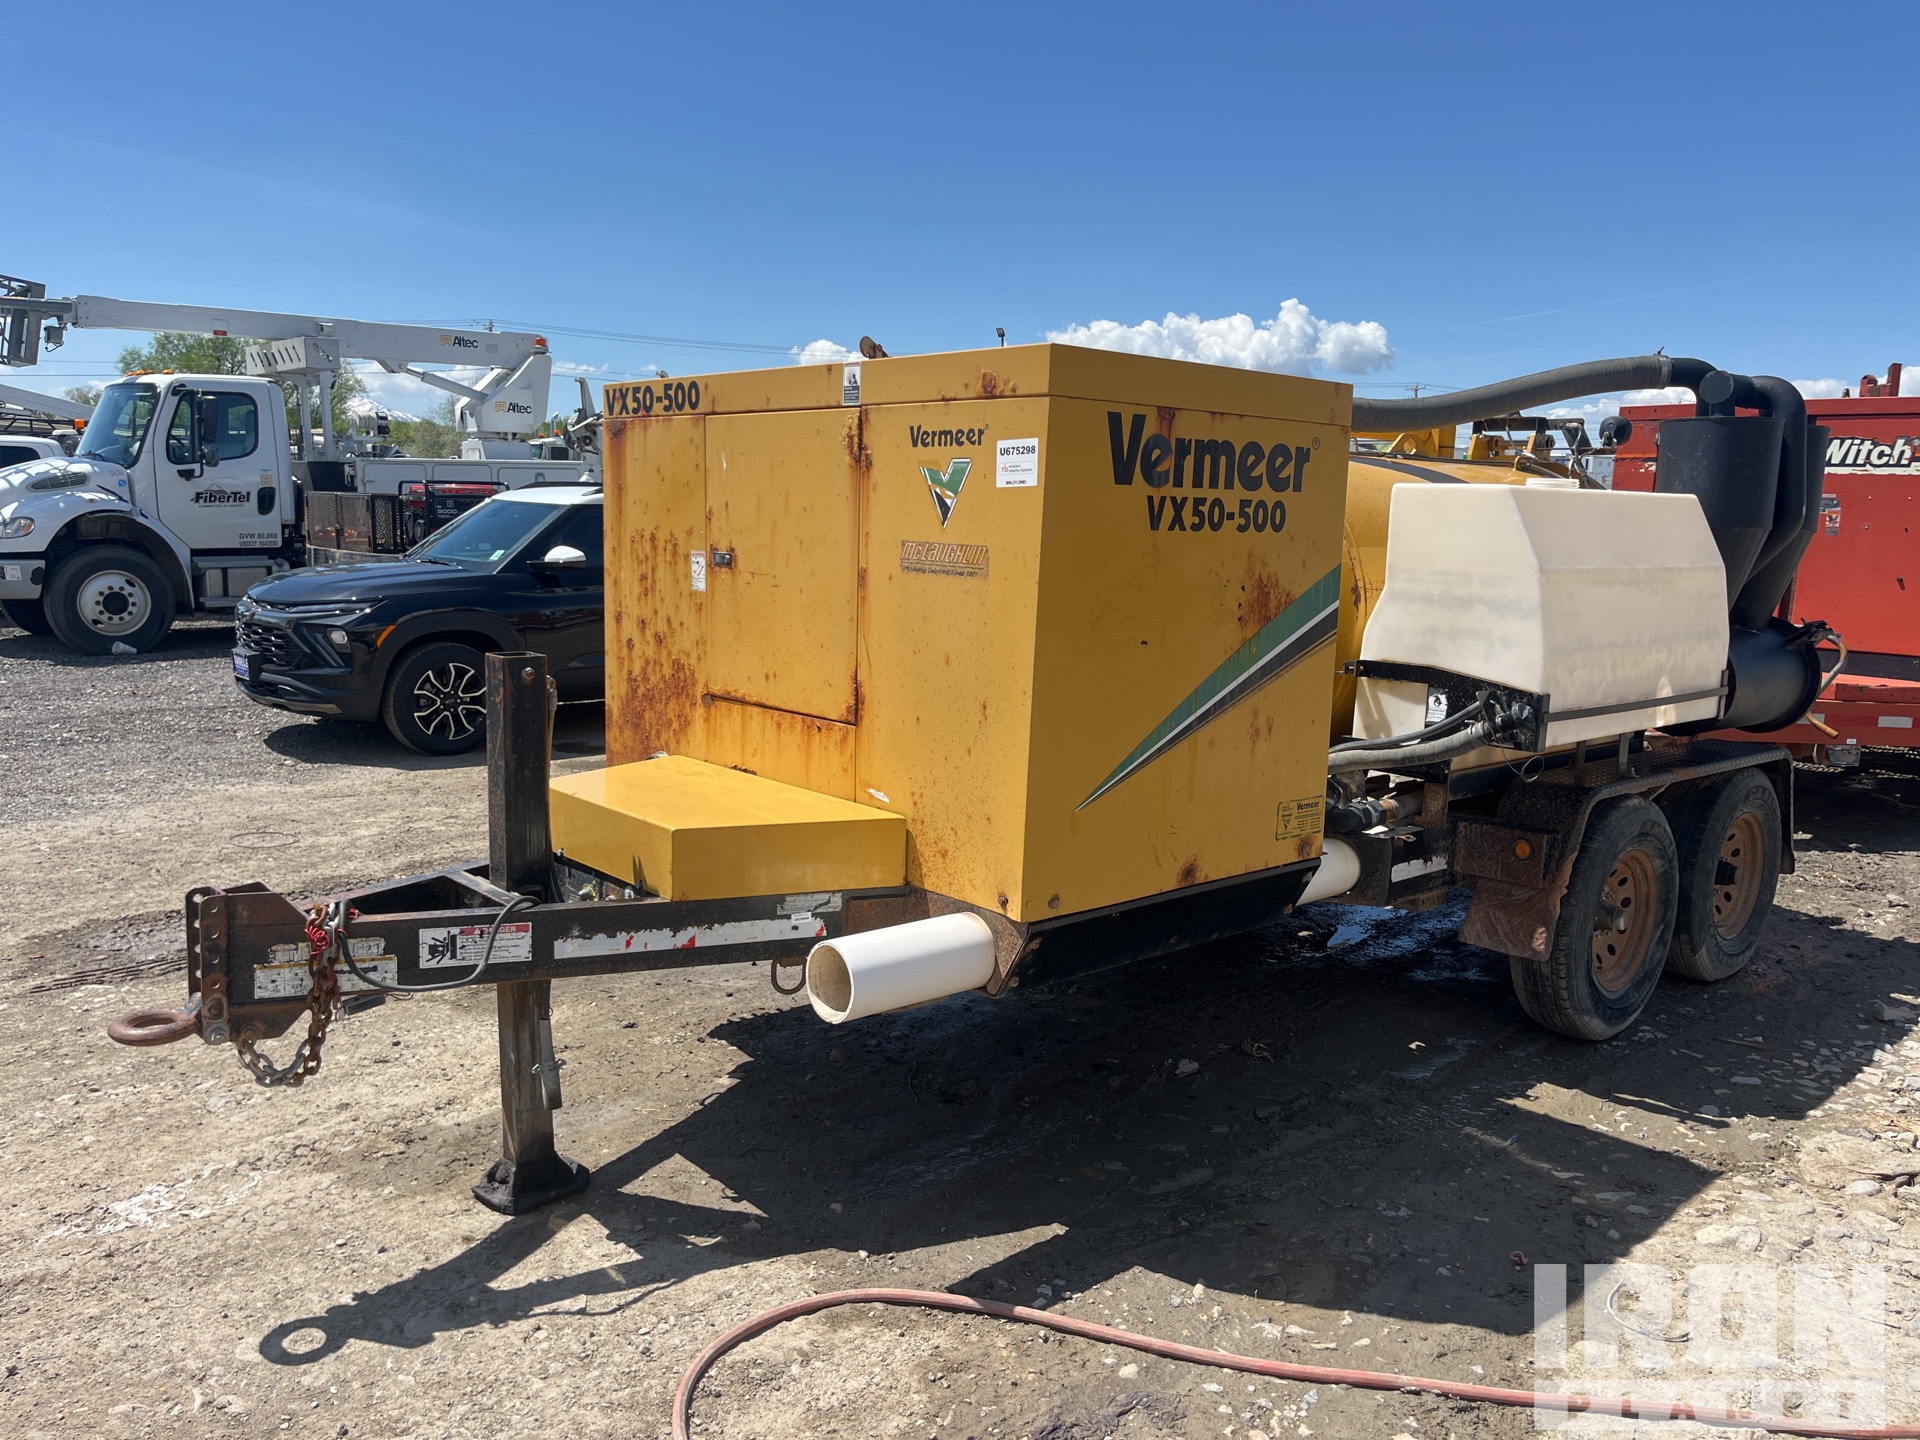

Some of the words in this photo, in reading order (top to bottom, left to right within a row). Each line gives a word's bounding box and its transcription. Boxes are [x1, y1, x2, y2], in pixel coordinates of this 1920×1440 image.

[452, 335, 479, 348] Altec
[605, 381, 700, 416] VX50-500
[507, 402, 532, 414] Altec
[999, 445, 1036, 456] U675298
[194, 491, 251, 504] FiberTel
[1147, 495, 1286, 533] VX50-500
[1296, 801, 1320, 811] Vermeer
[482, 925, 517, 934] DAGER
